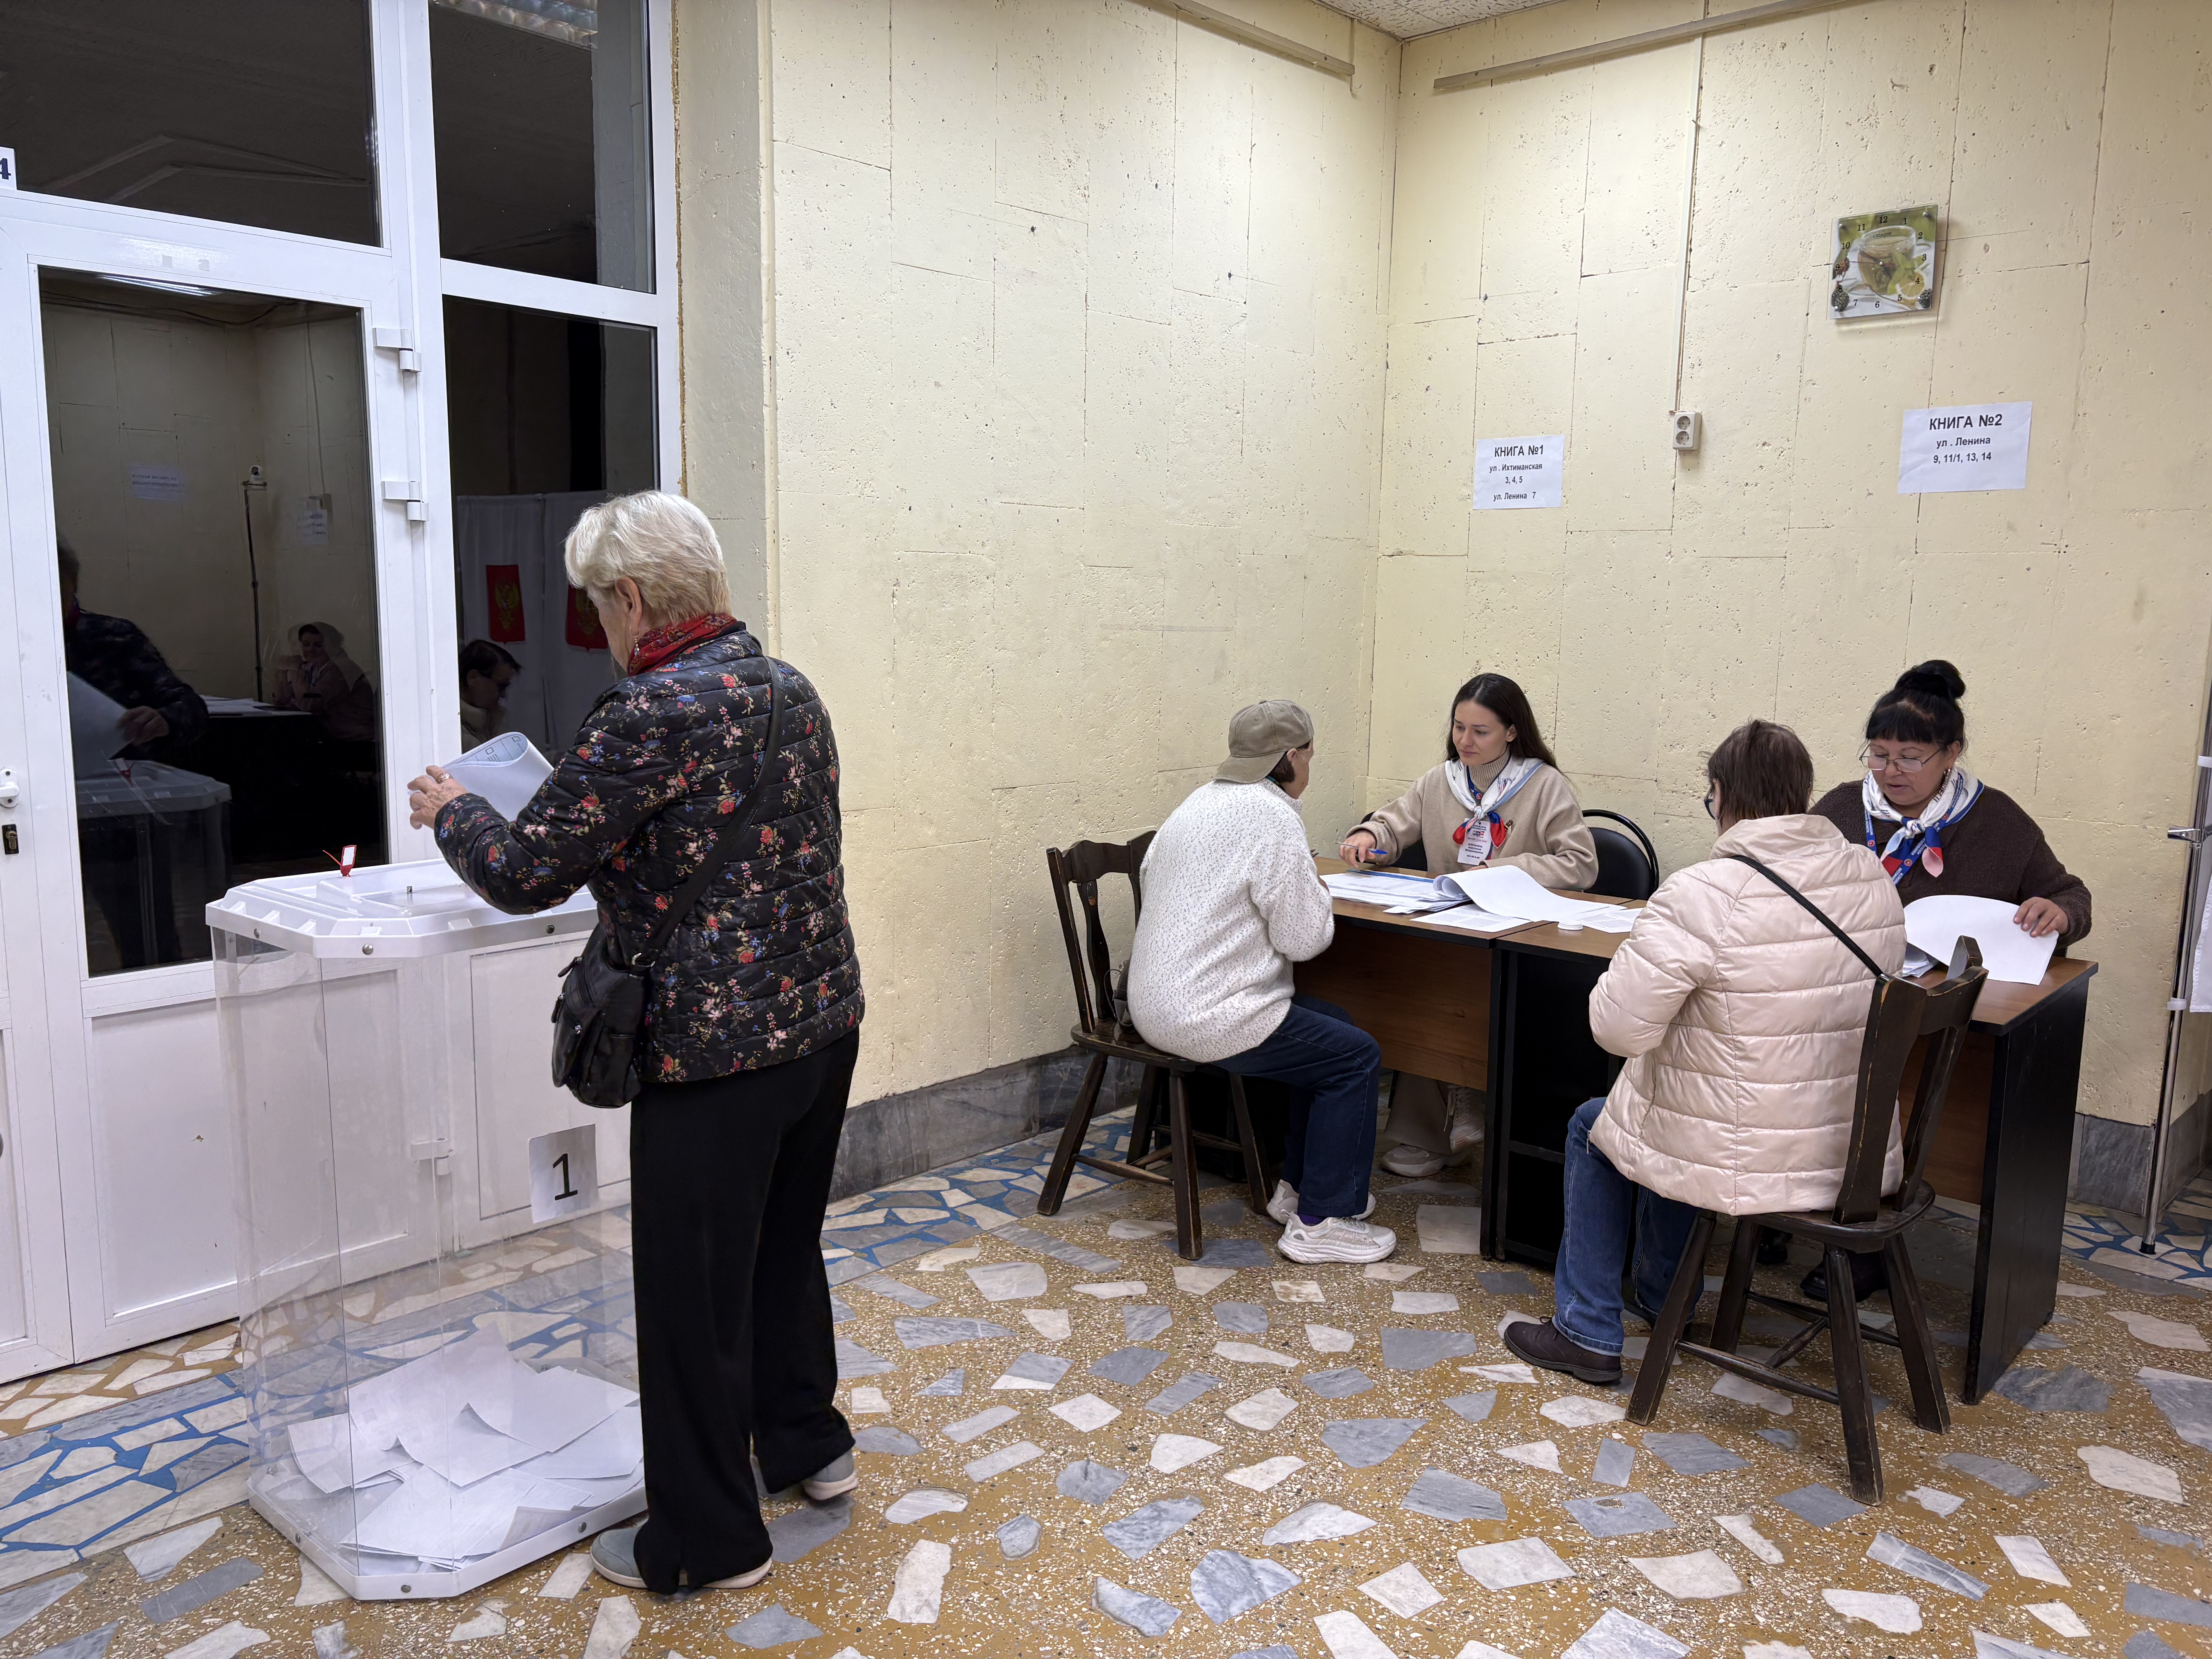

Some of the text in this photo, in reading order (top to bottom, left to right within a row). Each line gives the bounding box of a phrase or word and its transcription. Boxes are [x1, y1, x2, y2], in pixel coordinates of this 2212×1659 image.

[0, 158, 11, 180] 4
[1930, 414, 2002, 430] КНИГА №2
[1494, 445, 1543, 457] КНИГА №1
[1934, 455, 1941, 464] 9,
[1944, 454, 1963, 463] 11/1,
[1966, 453, 1978, 462] 13,
[1494, 493, 1502, 501] ул.
[553, 1153, 578, 1201] 1
